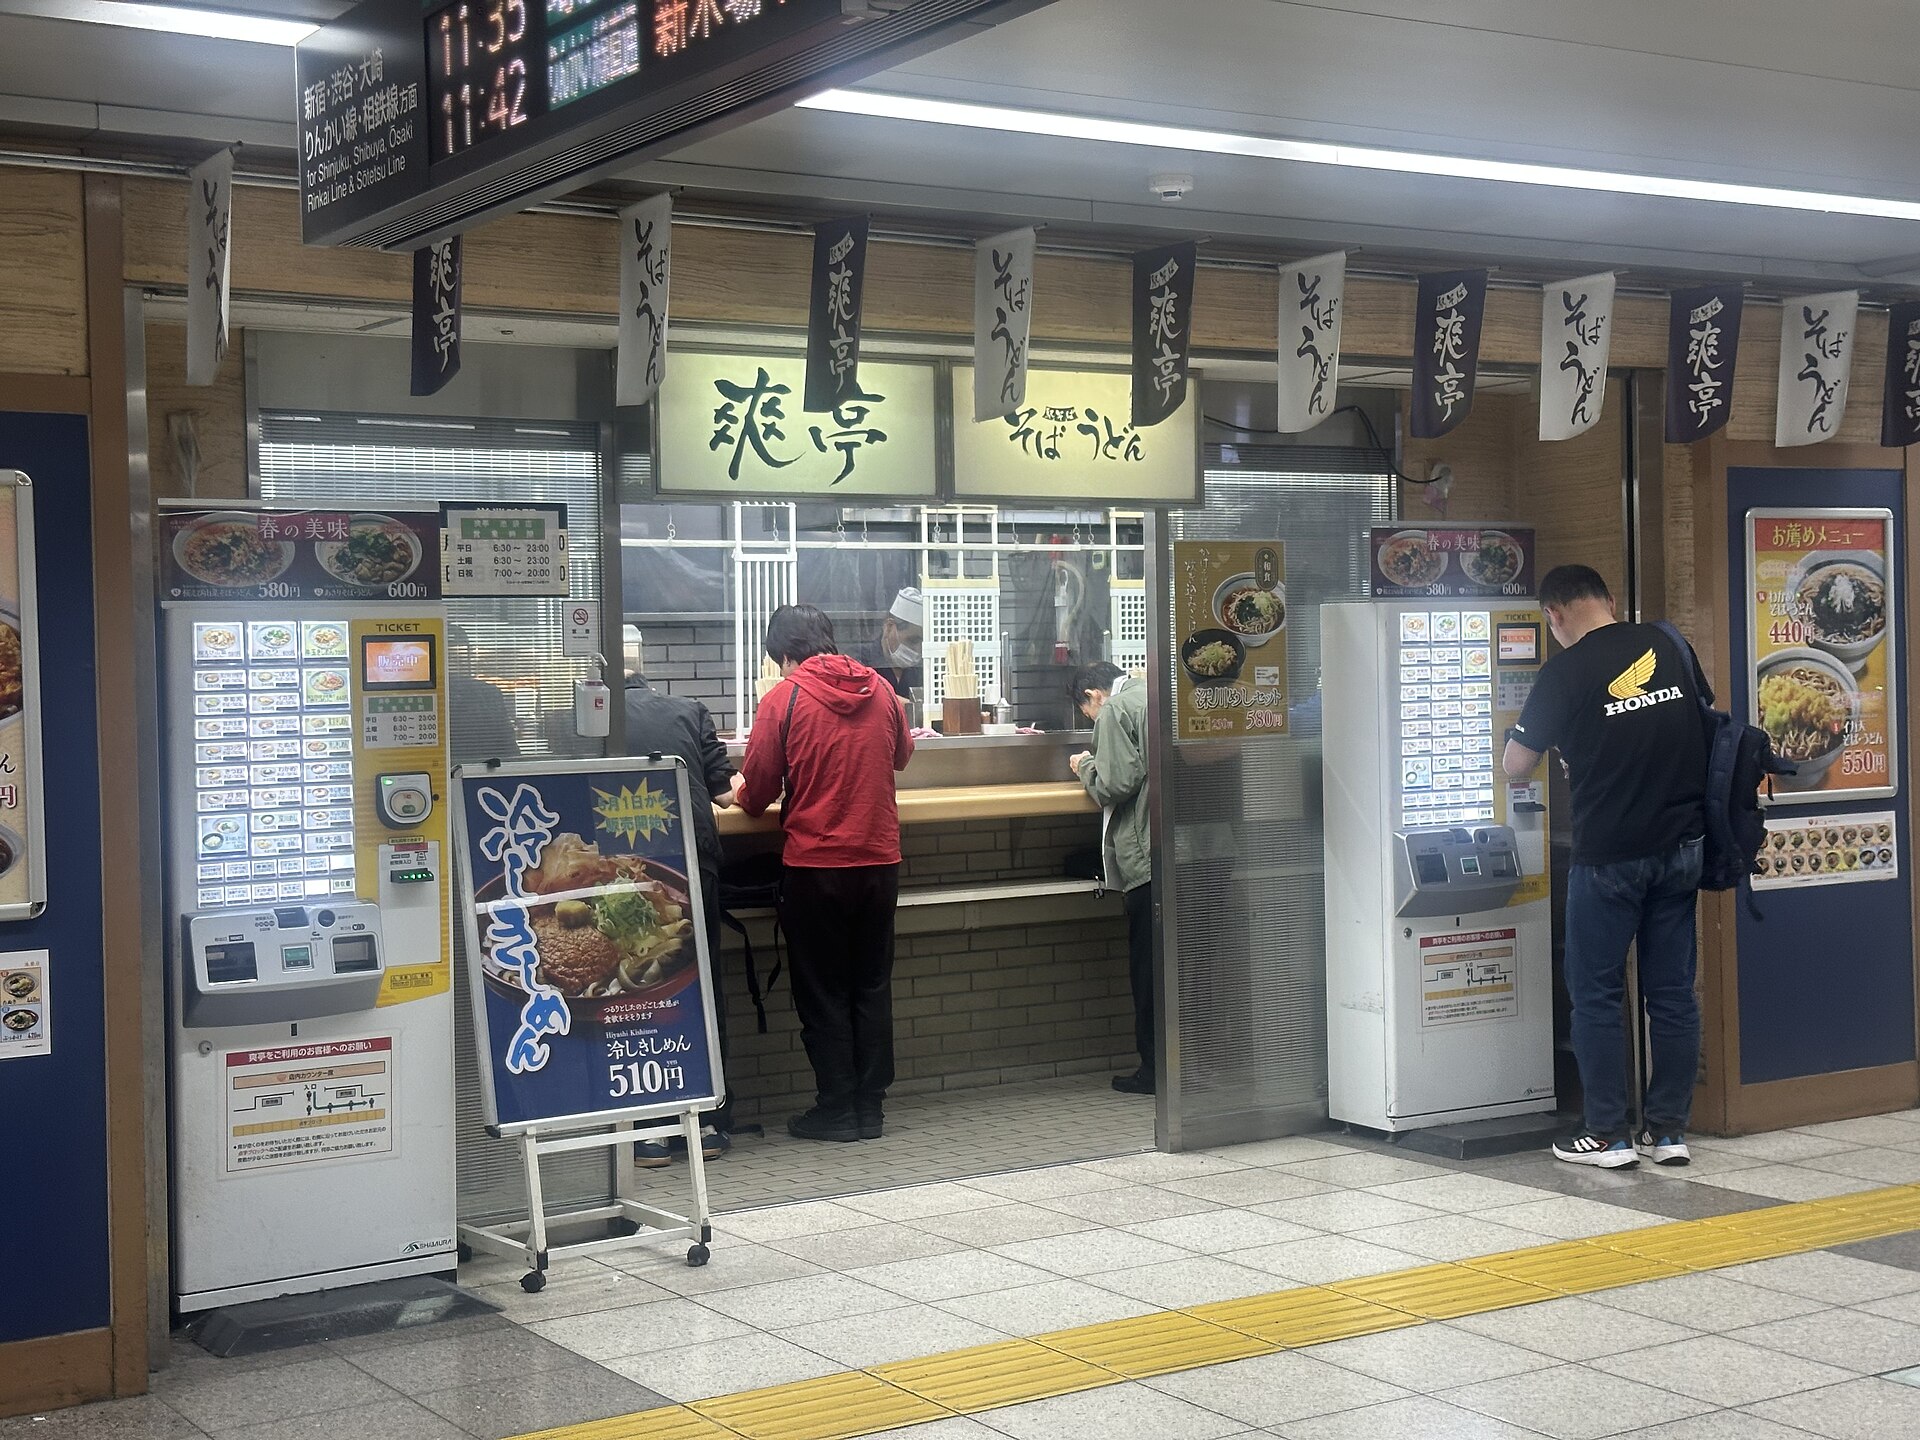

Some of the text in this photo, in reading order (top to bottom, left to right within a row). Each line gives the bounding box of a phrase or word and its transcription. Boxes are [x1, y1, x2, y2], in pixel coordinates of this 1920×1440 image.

[305, 47, 383, 120] 新宿・渋谷・大崎
[442, 58, 527, 153] 11:42
[307, 169, 317, 188] for
[318, 157, 352, 183] Shinjuku,
[354, 137, 388, 166] Shibuya,
[307, 186, 330, 213] Rinkai
[331, 181, 347, 202] Line
[349, 176, 355, 193] &
[388, 155, 406, 176] Line
[828, 261, 855, 393] 爽亭
[1150, 285, 1182, 407] 爽亭
[1433, 308, 1468, 422] 爽亭
[1687, 321, 1724, 428] 爽亭
[709, 367, 888, 486] 爽亭
[259, 517, 349, 540] 春の美味
[1772, 523, 1864, 548] お薦めメニュー
[457, 544, 472, 552] 平日
[527, 544, 549, 552] 23:00
[1427, 534, 1481, 551] 春の美味
[527, 557, 550, 565] 23:00
[527, 569, 550, 578] 20:00
[258, 582, 300, 598] 580円
[388, 582, 427, 598] 600円
[1502, 583, 1527, 595] 600円
[376, 623, 420, 632] TICKET
[1769, 621, 1815, 645] 440円
[1195, 687, 1282, 709] 深川めしセット
[1604, 686, 1683, 717] HONDA
[1246, 709, 1283, 730] 580円
[1842, 748, 1886, 775] 550円
[249, 1042, 372, 1062] 爽亭をご利用のお客様へのお願い
[606, 1035, 692, 1060] 冷しきしめん
[609, 1060, 684, 1097] 510円
